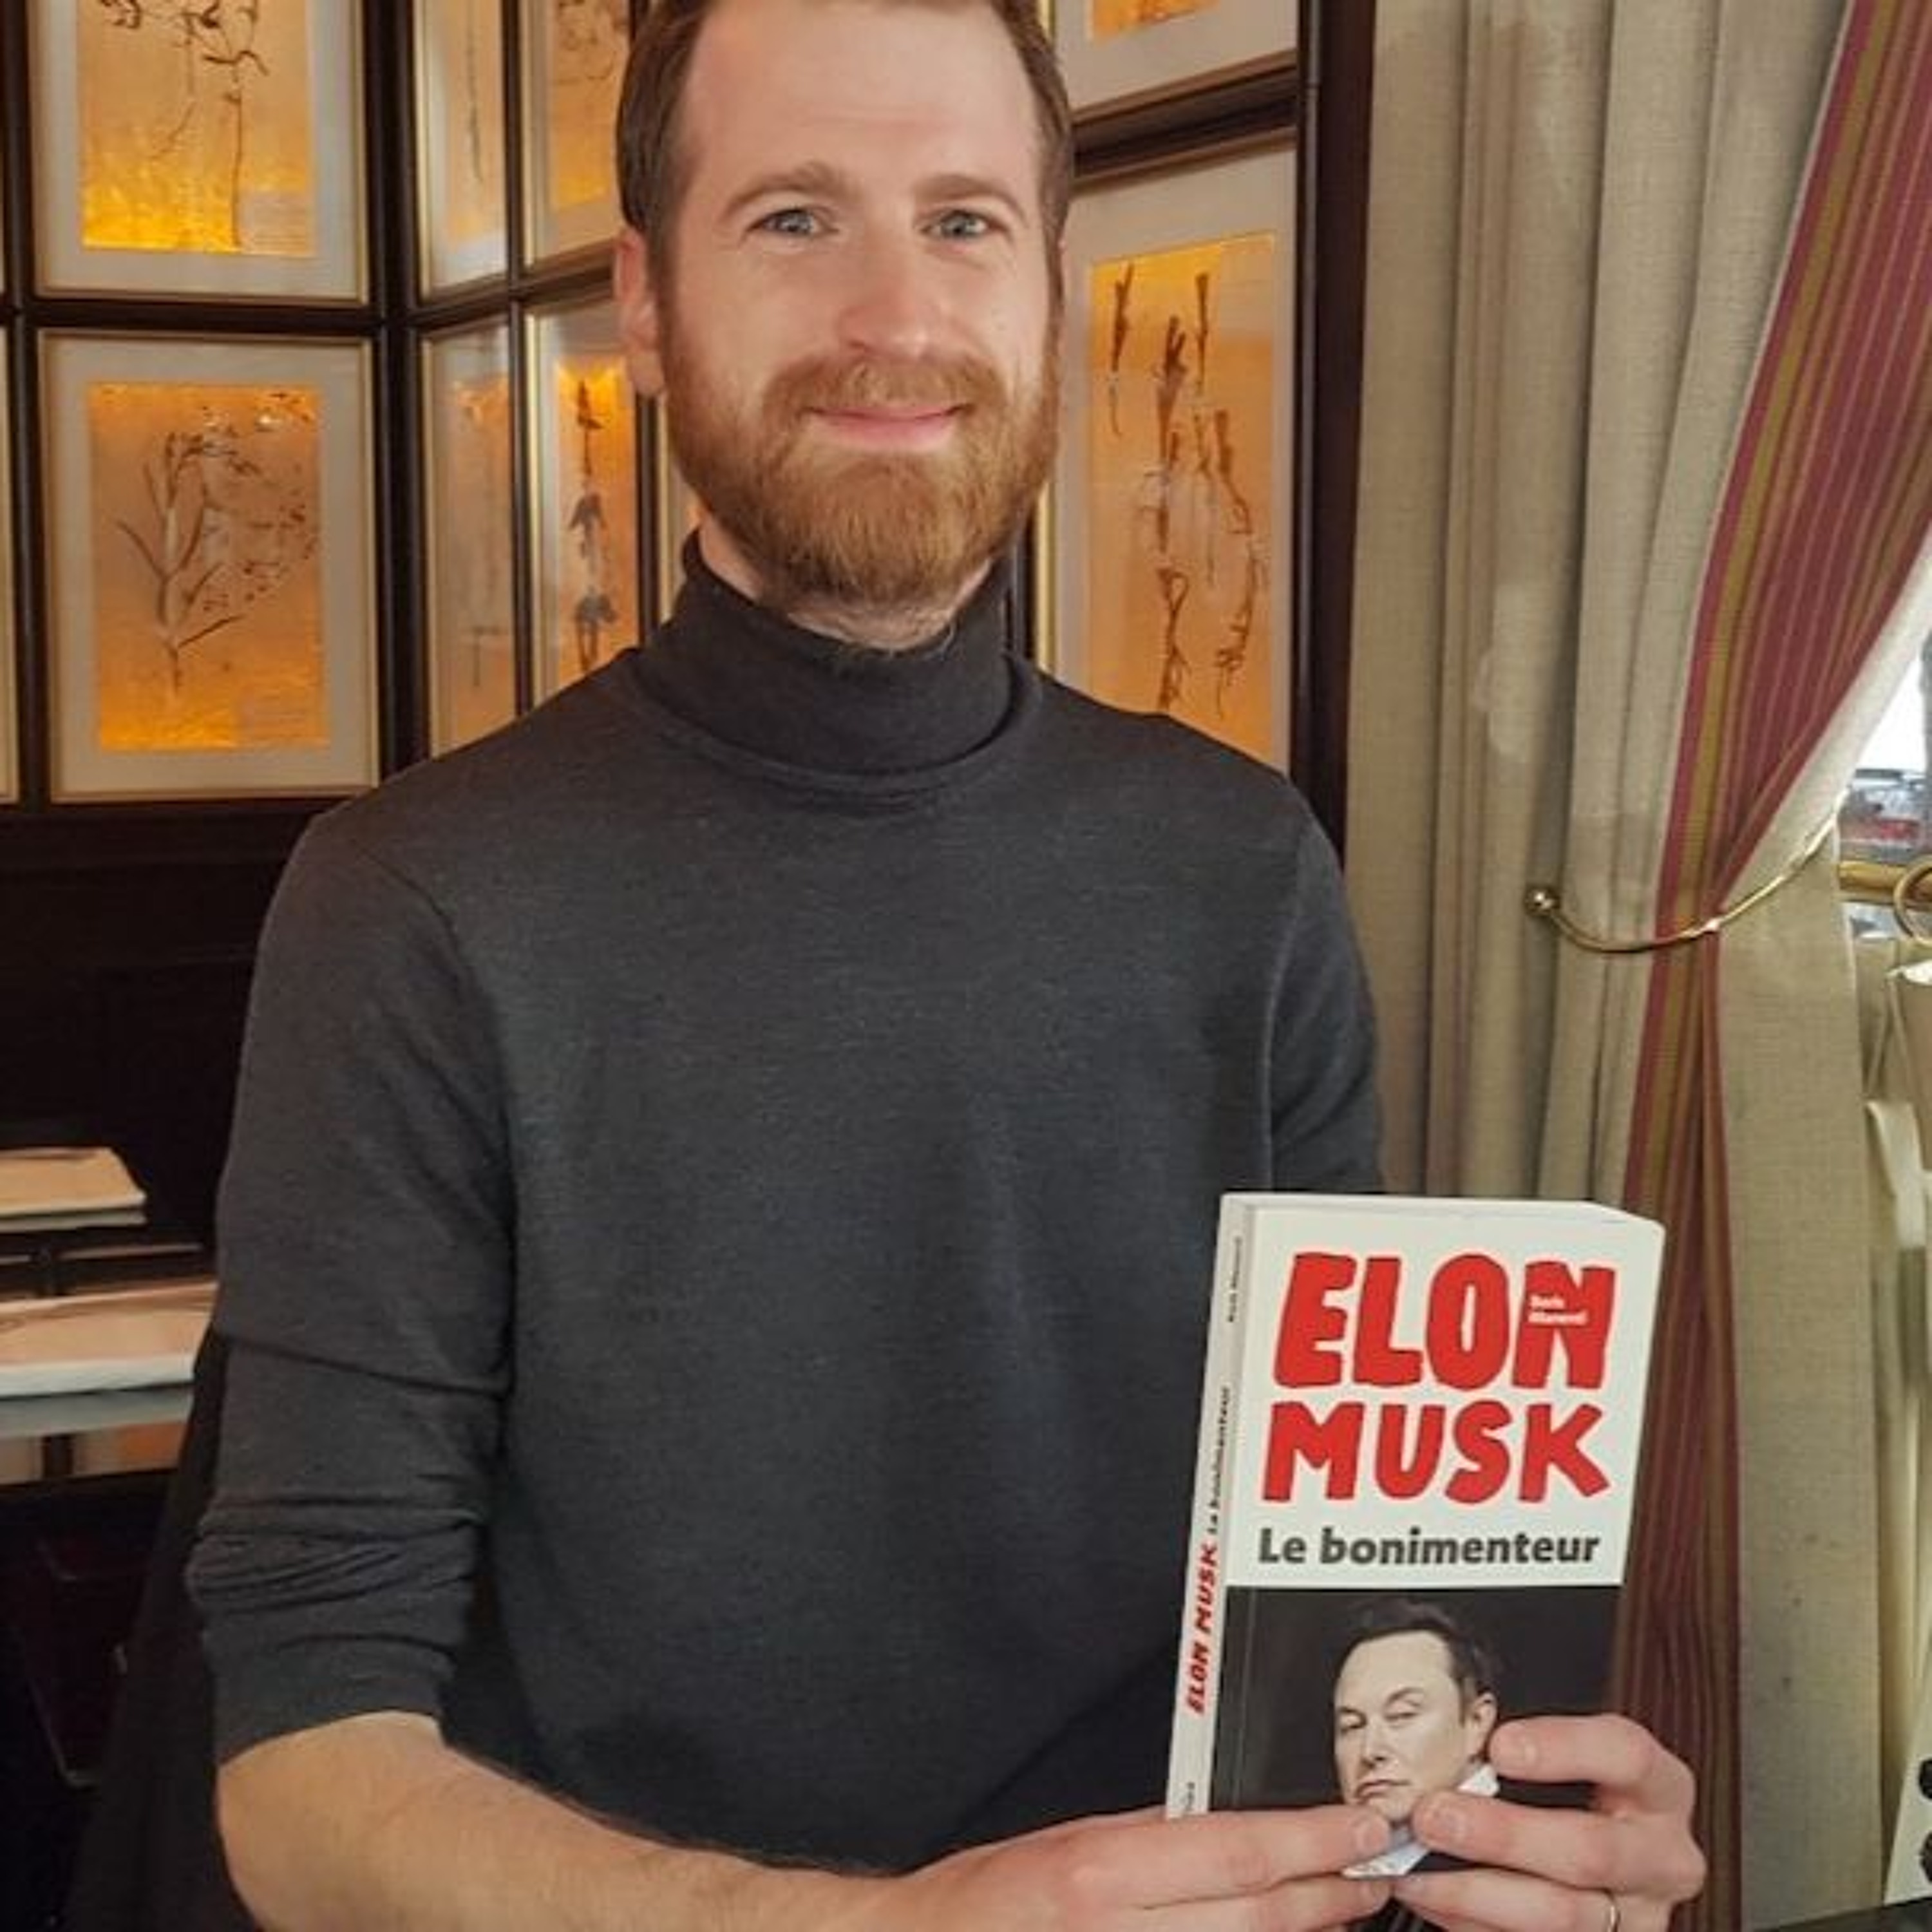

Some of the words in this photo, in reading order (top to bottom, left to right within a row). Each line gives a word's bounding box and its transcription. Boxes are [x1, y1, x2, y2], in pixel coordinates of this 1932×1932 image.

[1274, 1252, 1615, 1390] ELON
[1263, 1400, 1609, 1503] MUSK
[1195, 1543, 1218, 1633] MUSK
[1258, 1528, 1306, 1562] Le
[1321, 1527, 1600, 1564] bonimenteur
[1186, 1642, 1209, 1713] ELON
